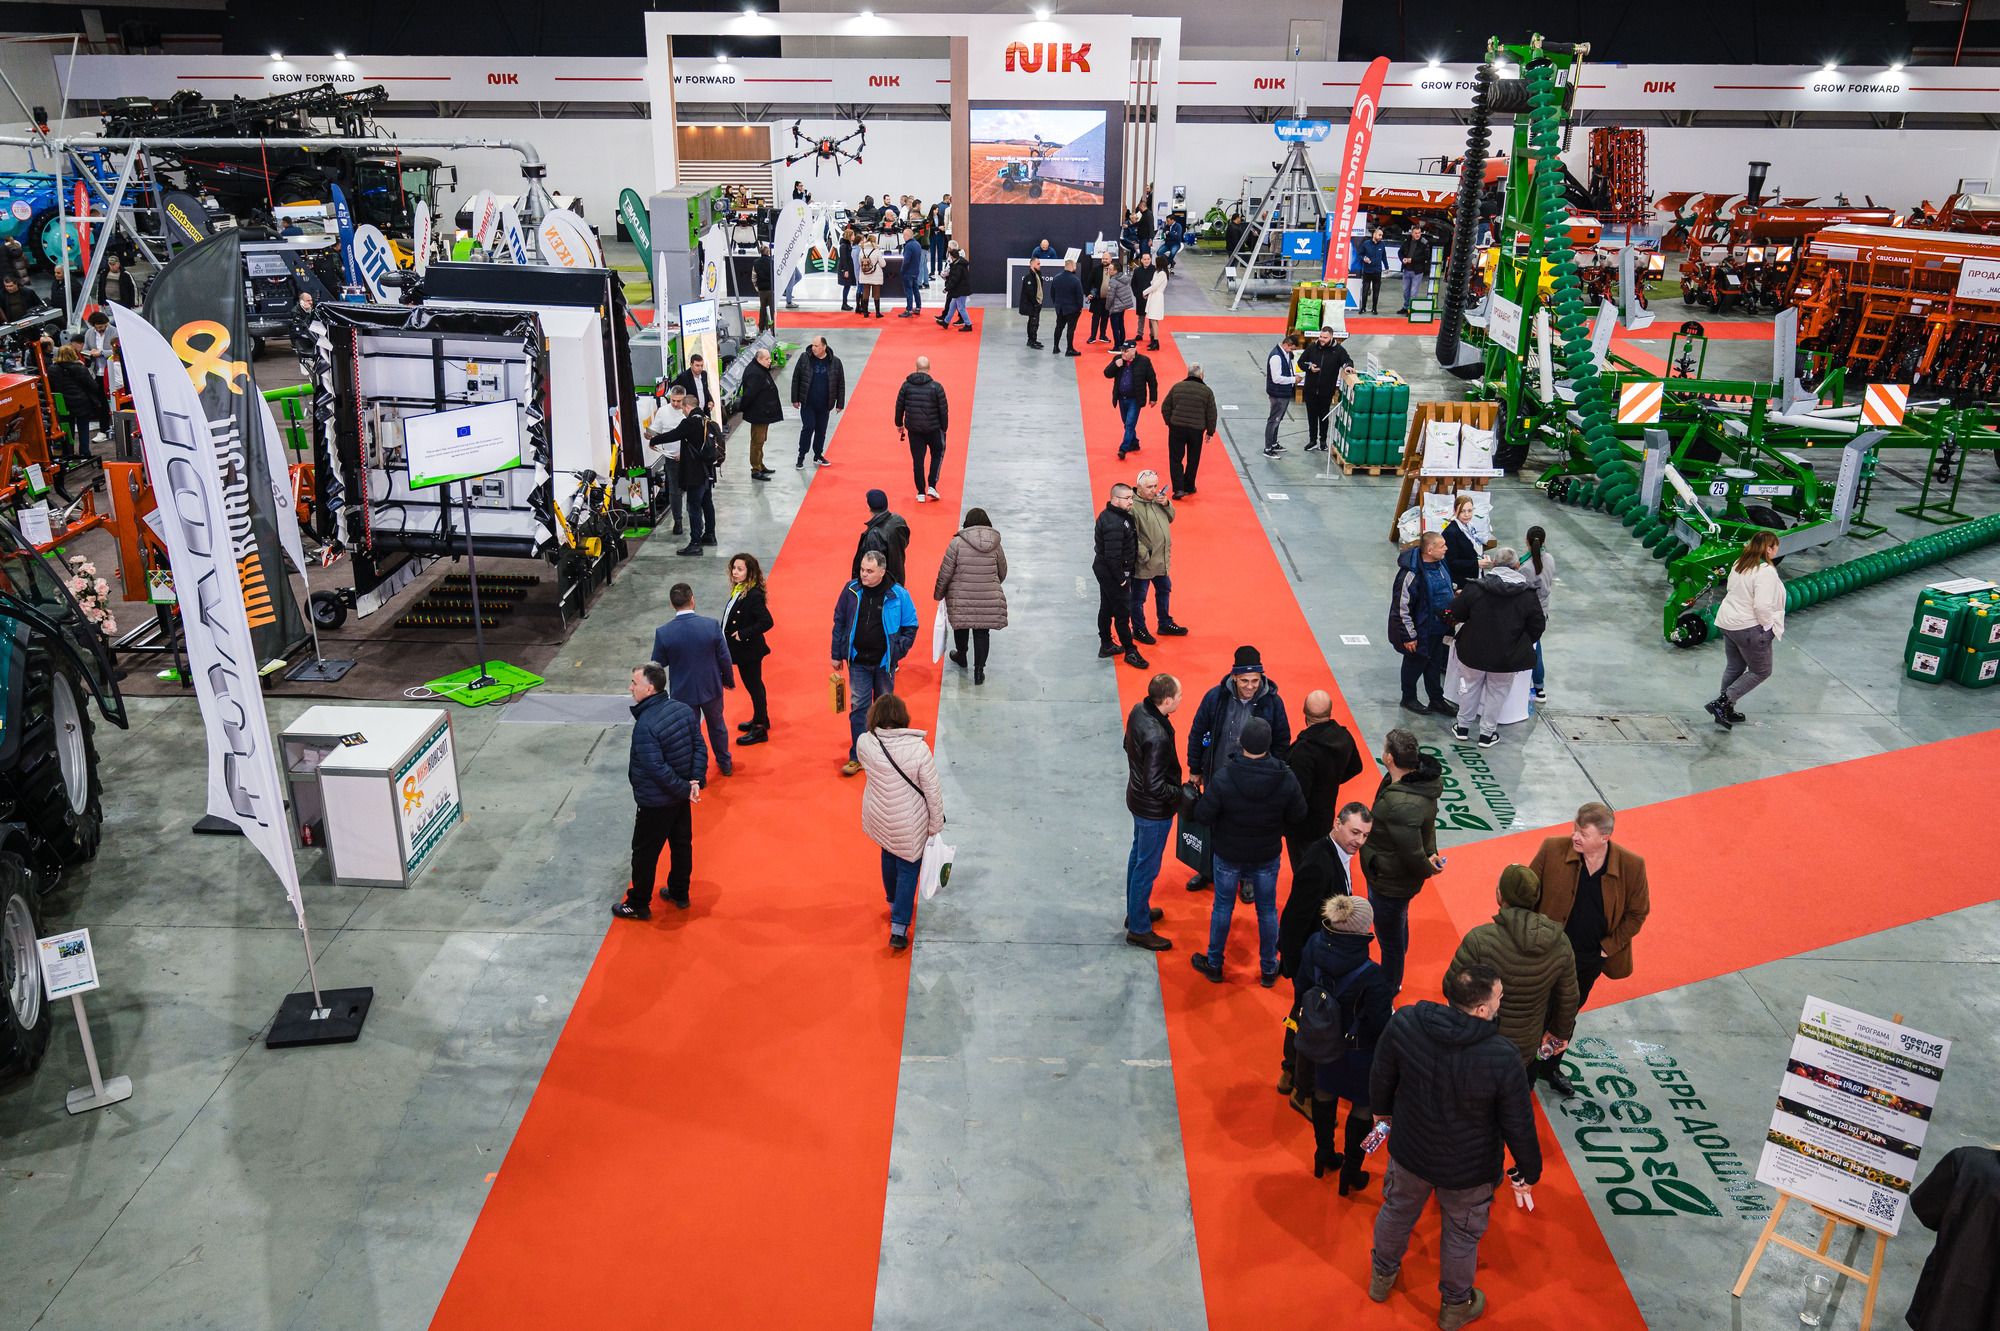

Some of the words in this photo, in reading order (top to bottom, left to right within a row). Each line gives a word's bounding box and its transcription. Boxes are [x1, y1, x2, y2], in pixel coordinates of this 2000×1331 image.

[1005, 42, 1092, 74] NIK
[272, 73, 301, 83] GROW
[303, 73, 356, 83] FORWARD
[487, 73, 518, 85] NIK
[685, 75, 736, 84] FORWARD
[869, 75, 900, 87] NIK
[1253, 77, 1285, 89] NIK
[1421, 81, 1453, 90] GROW
[1643, 81, 1676, 93] NIK
[1813, 84, 1846, 93] GROW
[1848, 84, 1900, 93] FORWARD
[1278, 126, 1315, 138] VALLEY
[1335, 131, 1365, 260] CRUCIANELLI
[1713, 482, 1725, 495] 25
[1856, 1023, 1890, 1040] ПРОГРАМА
[1899, 1032, 1930, 1049] green
[1837, 1121, 1858, 1134] (20.02)
